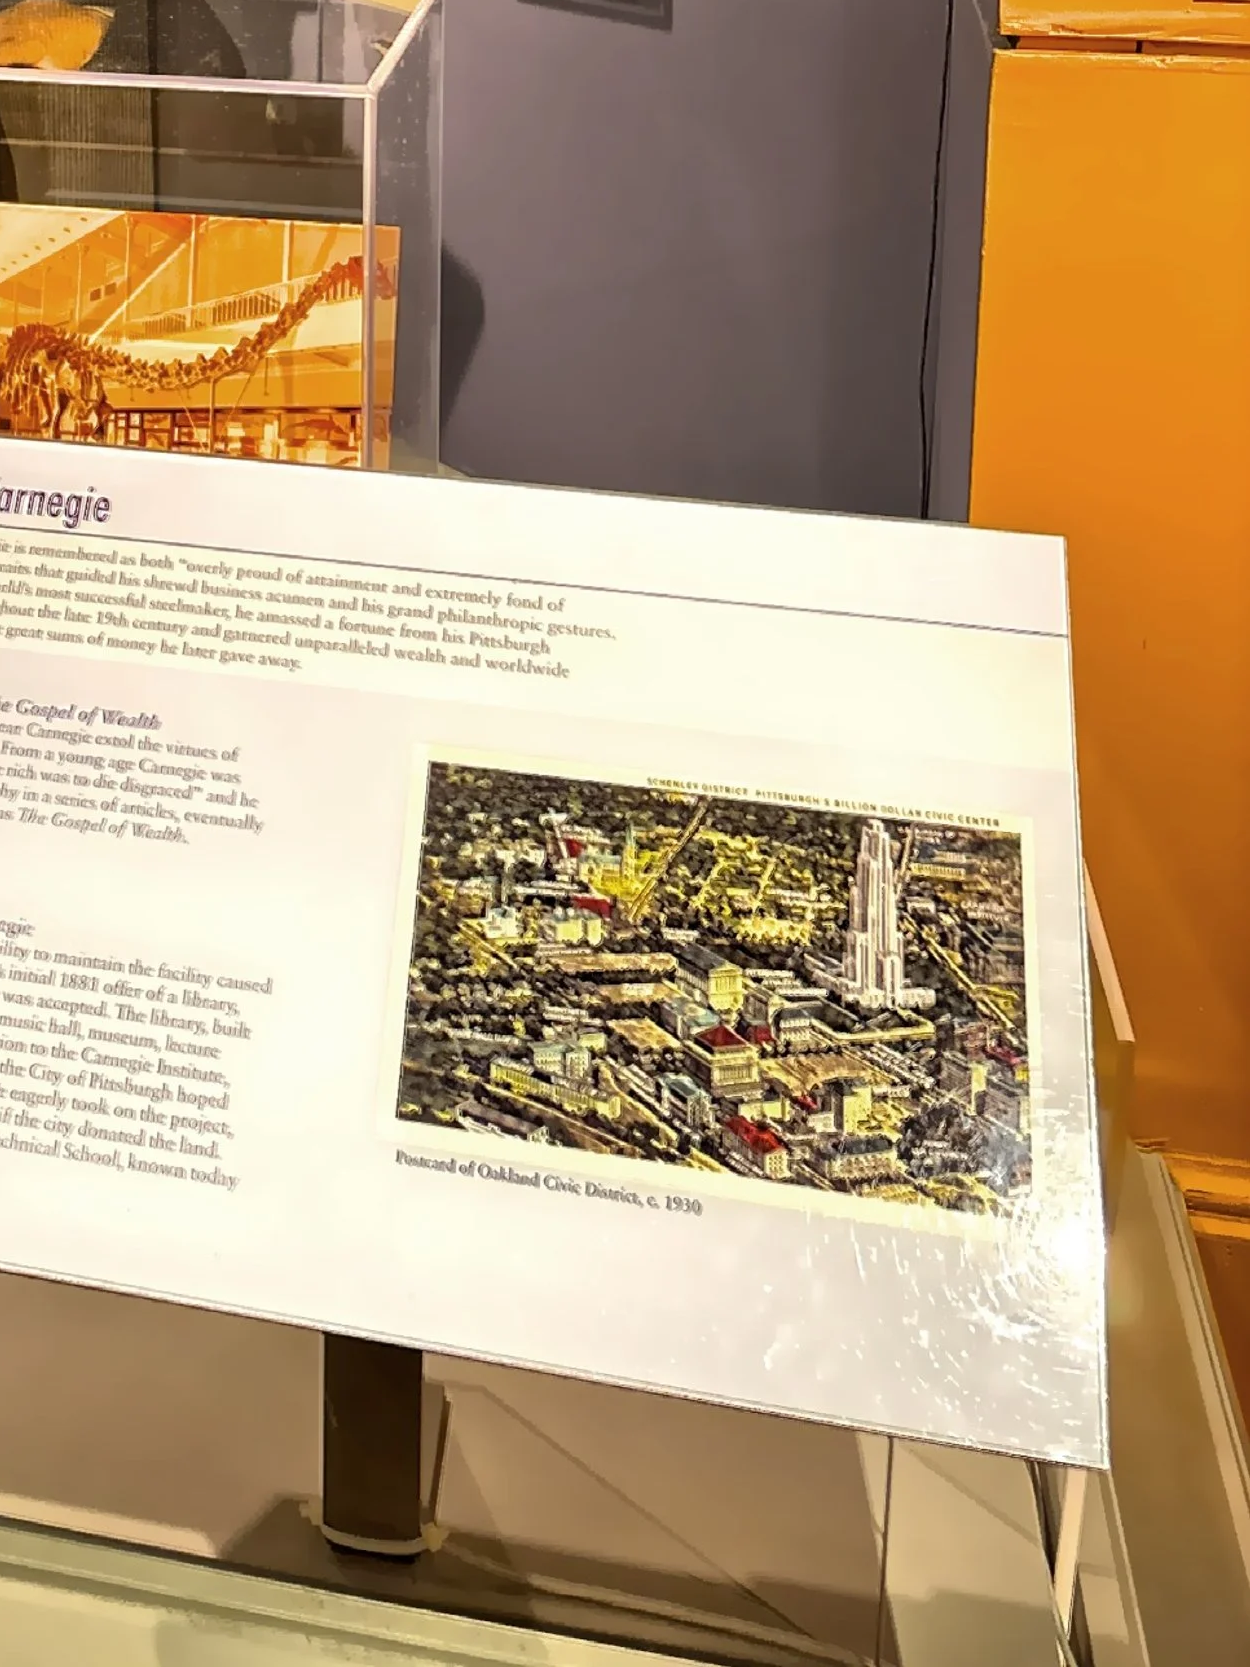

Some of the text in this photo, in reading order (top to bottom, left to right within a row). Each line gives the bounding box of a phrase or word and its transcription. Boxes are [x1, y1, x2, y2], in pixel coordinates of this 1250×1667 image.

[13, 539, 27, 555] is
[27, 545, 119, 565] remembered
[118, 555, 137, 567] as
[139, 551, 175, 571] both
[235, 566, 284, 582] proud
[284, 568, 305, 585] of
[304, 573, 389, 594] attainment
[391, 582, 423, 598] and
[424, 587, 503, 610] extremely
[506, 591, 544, 611] fond
[546, 597, 567, 613] of
[33, 562, 65, 580] that
[64, 566, 118, 586] guided
[117, 570, 142, 588] his
[142, 573, 199, 594] shrewd
[200, 579, 264, 601] business
[264, 591, 326, 609] acumen
[327, 596, 360, 612] and
[360, 597, 385, 615] his
[386, 604, 435, 620] grand
[436, 607, 544, 635] philanthropic
[3, 625, 45, 641] great
[45, 630, 85, 645] sums
[86, 630, 106, 648] of
[105, 637, 159, 656] money
[159, 637, 180, 656] he
[181, 640, 219, 660] later
[218, 649, 256, 665] gave
[34, 586, 73, 602] most
[73, 591, 148, 610] successful
[148, 597, 232, 622] steelmaker,
[234, 603, 255, 622] he
[255, 611, 323, 629] amassed
[323, 619, 335, 631] a
[338, 615, 397, 638] fortune
[399, 622, 438, 643] from
[441, 627, 466, 645] his
[468, 630, 551, 657] Pittsburgh
[37, 603, 63, 622] the
[63, 605, 93, 624] late
[95, 610, 130, 629] 19th
[131, 618, 190, 638] century
[190, 622, 223, 639] and
[222, 629, 292, 647] garnered
[294, 637, 391, 659] unparalleled
[393, 646, 447, 665] wealth
[449, 652, 482, 669] and
[484, 657, 570, 679] worldwide
[15, 698, 79, 724] Gospel
[77, 705, 103, 727] of
[100, 708, 163, 731] Wealth
[17, 806, 49, 826] The
[50, 811, 109, 835] Gospel
[107, 819, 130, 839] of
[130, 821, 190, 845] Wealth.
[701, 783, 749, 796] DISTRICT
[834, 798, 878, 812] BILLION
[924, 810, 954, 822] CIVIC
[957, 814, 1000, 827] CENTER
[32, 948, 54, 963] to
[52, 951, 126, 974] maintain
[127, 958, 160, 978] the
[156, 961, 214, 990] facility
[216, 976, 274, 996] caused
[62, 1141, 125, 1173] School,
[126, 1151, 188, 1180] known
[190, 1166, 240, 1192] today
[395, 1149, 703, 1216] Postcard of Oakland Civic District, c. 1930
